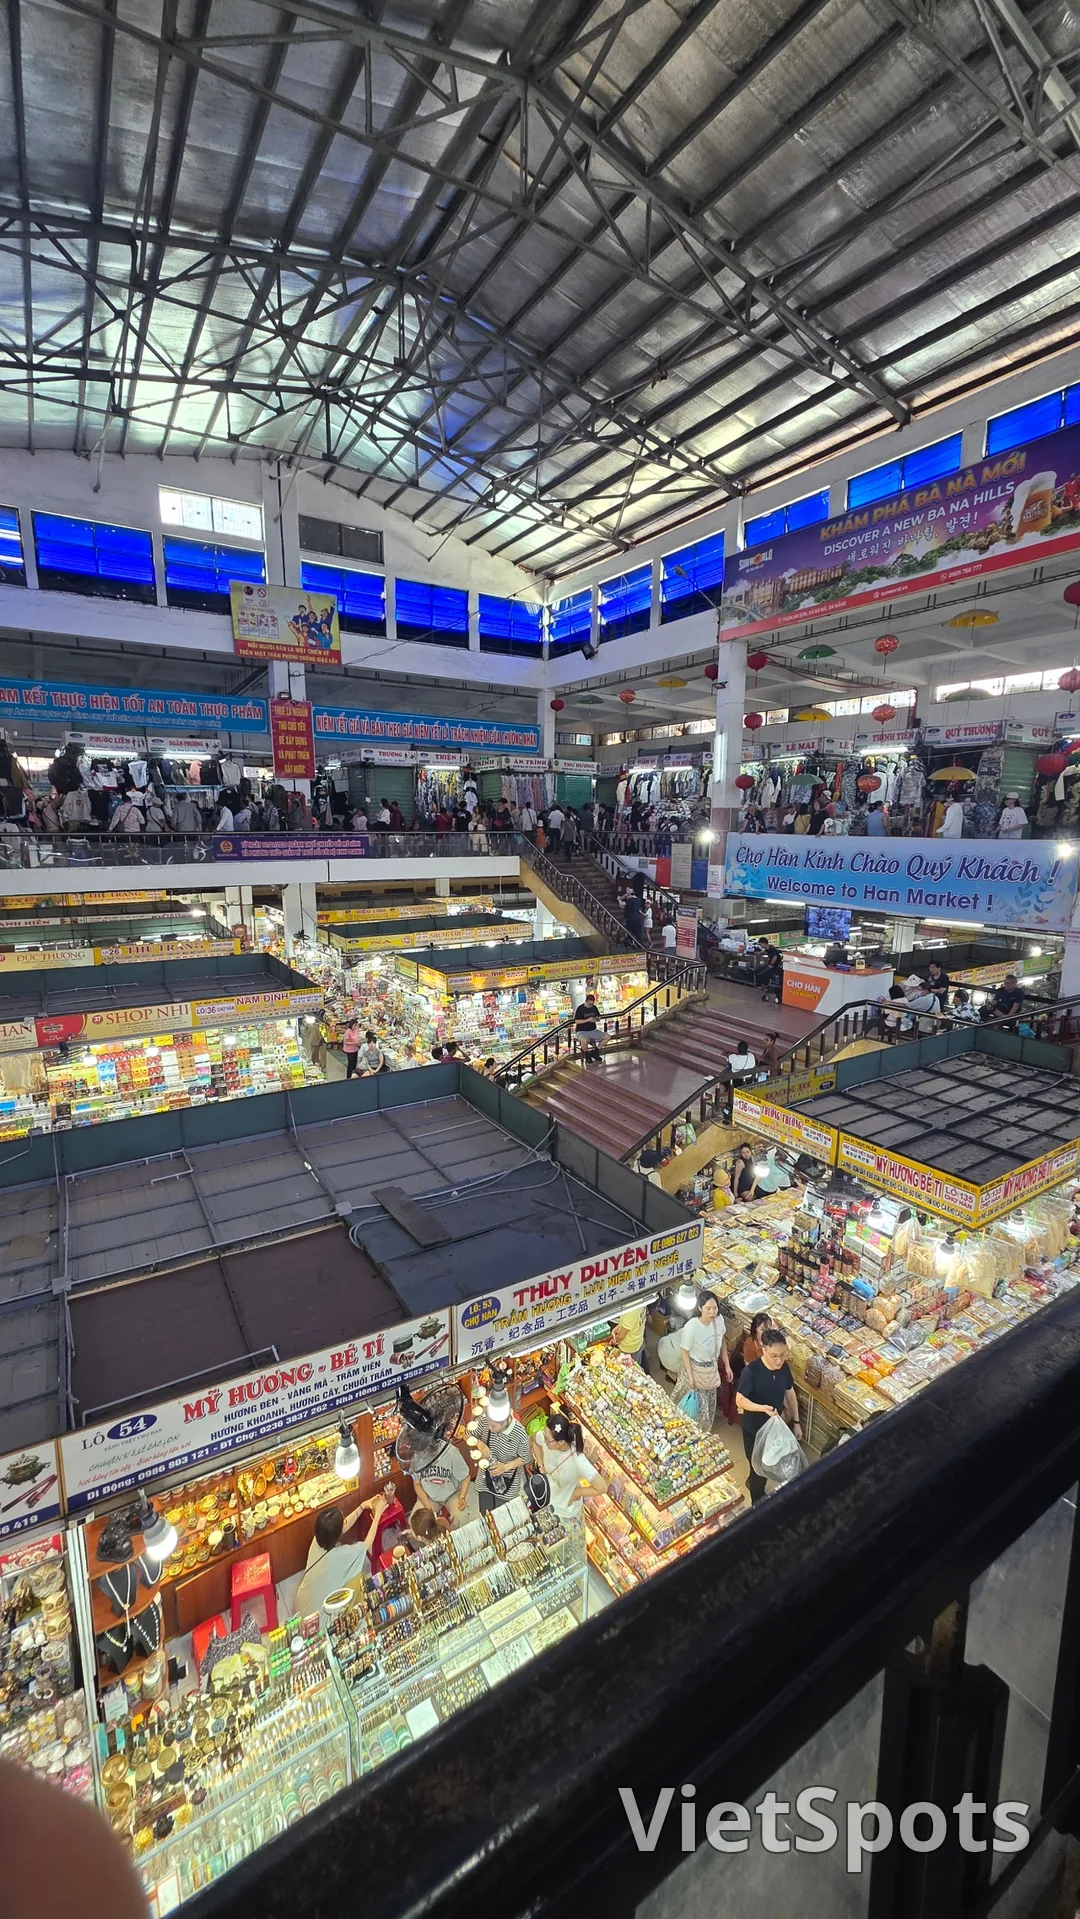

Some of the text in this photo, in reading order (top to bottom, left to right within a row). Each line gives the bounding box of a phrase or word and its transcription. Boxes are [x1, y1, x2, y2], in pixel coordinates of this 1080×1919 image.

[820, 451, 1026, 543] KHÁM PHÁ BÀ NÀ MỚI
[823, 481, 1015, 556] DISCOVER A NEW BA NA HILLS
[0, 686, 263, 720] AM KẾT THỰC HIỆN TỐT AN TOÀN THỰC PHẨM
[361, 716, 370, 735] VÀ
[371, 717, 384, 736] BÁN
[385, 721, 401, 737] THEO
[441, 722, 450, 740] LÀ
[450, 723, 469, 742] TRÁCH
[735, 845, 765, 869] Chợ
[766, 846, 799, 869] Hàn
[804, 849, 845, 872] Kính
[850, 852, 901, 875] Chào
[906, 853, 953, 882] Quý
[956, 856, 1041, 883] Khách
[767, 876, 836, 896] Welcome
[841, 882, 857, 898] to
[863, 884, 900, 903] Han
[906, 887, 980, 910] Market
[17, 951, 40, 963] ĐỨC
[109, 948, 120, 956] 26
[236, 994, 260, 1005] NAM
[786, 979, 821, 993] CHỢ HÀN
[105, 1007, 153, 1025] SHOP
[157, 1002, 190, 1017] NHI
[875, 1154, 888, 1173] MỸ
[889, 1161, 919, 1188] HƯƠNG
[580, 1244, 648, 1284] DUYÊN
[492, 1308, 527, 1332] TRẦM
[531, 1292, 572, 1316] HƯƠNG
[607, 1268, 632, 1289] NIỆM
[635, 1260, 650, 1278] MỸ
[653, 1249, 679, 1270] NGHỆ
[597, 1287, 617, 1305] 진주
[668, 1258, 693, 1277] 기념품
[464, 1308, 497, 1328] CHỢ HÀN
[483, 1299, 492, 1310] 53
[471, 1299, 588, 1356] 沉香 纪念品 工艺品
[183, 1333, 385, 1424] MỸ HƯƠNG BÉ TÍ
[224, 1404, 257, 1423] HƯƠNG
[287, 1383, 311, 1400] VÀNG
[362, 1359, 381, 1374] VIÊN
[81, 1417, 147, 1451] LÔ 54
[102, 1476, 136, 1494] Động:
[138, 1465, 166, 1481] 0986
[168, 1456, 189, 1469] 803
[191, 1448, 210, 1462] 121
[220, 1439, 234, 1450] ĐT
[260, 1421, 284, 1435] 0236
[285, 1411, 309, 1425] 3837
[311, 1402, 328, 1415] 262
[336, 1395, 354, 1406] Nhà
[382, 1375, 402, 1388] 0236
[210, 1424, 244, 1441] HƯƠNG
[290, 1394, 320, 1412] HƯƠNG
